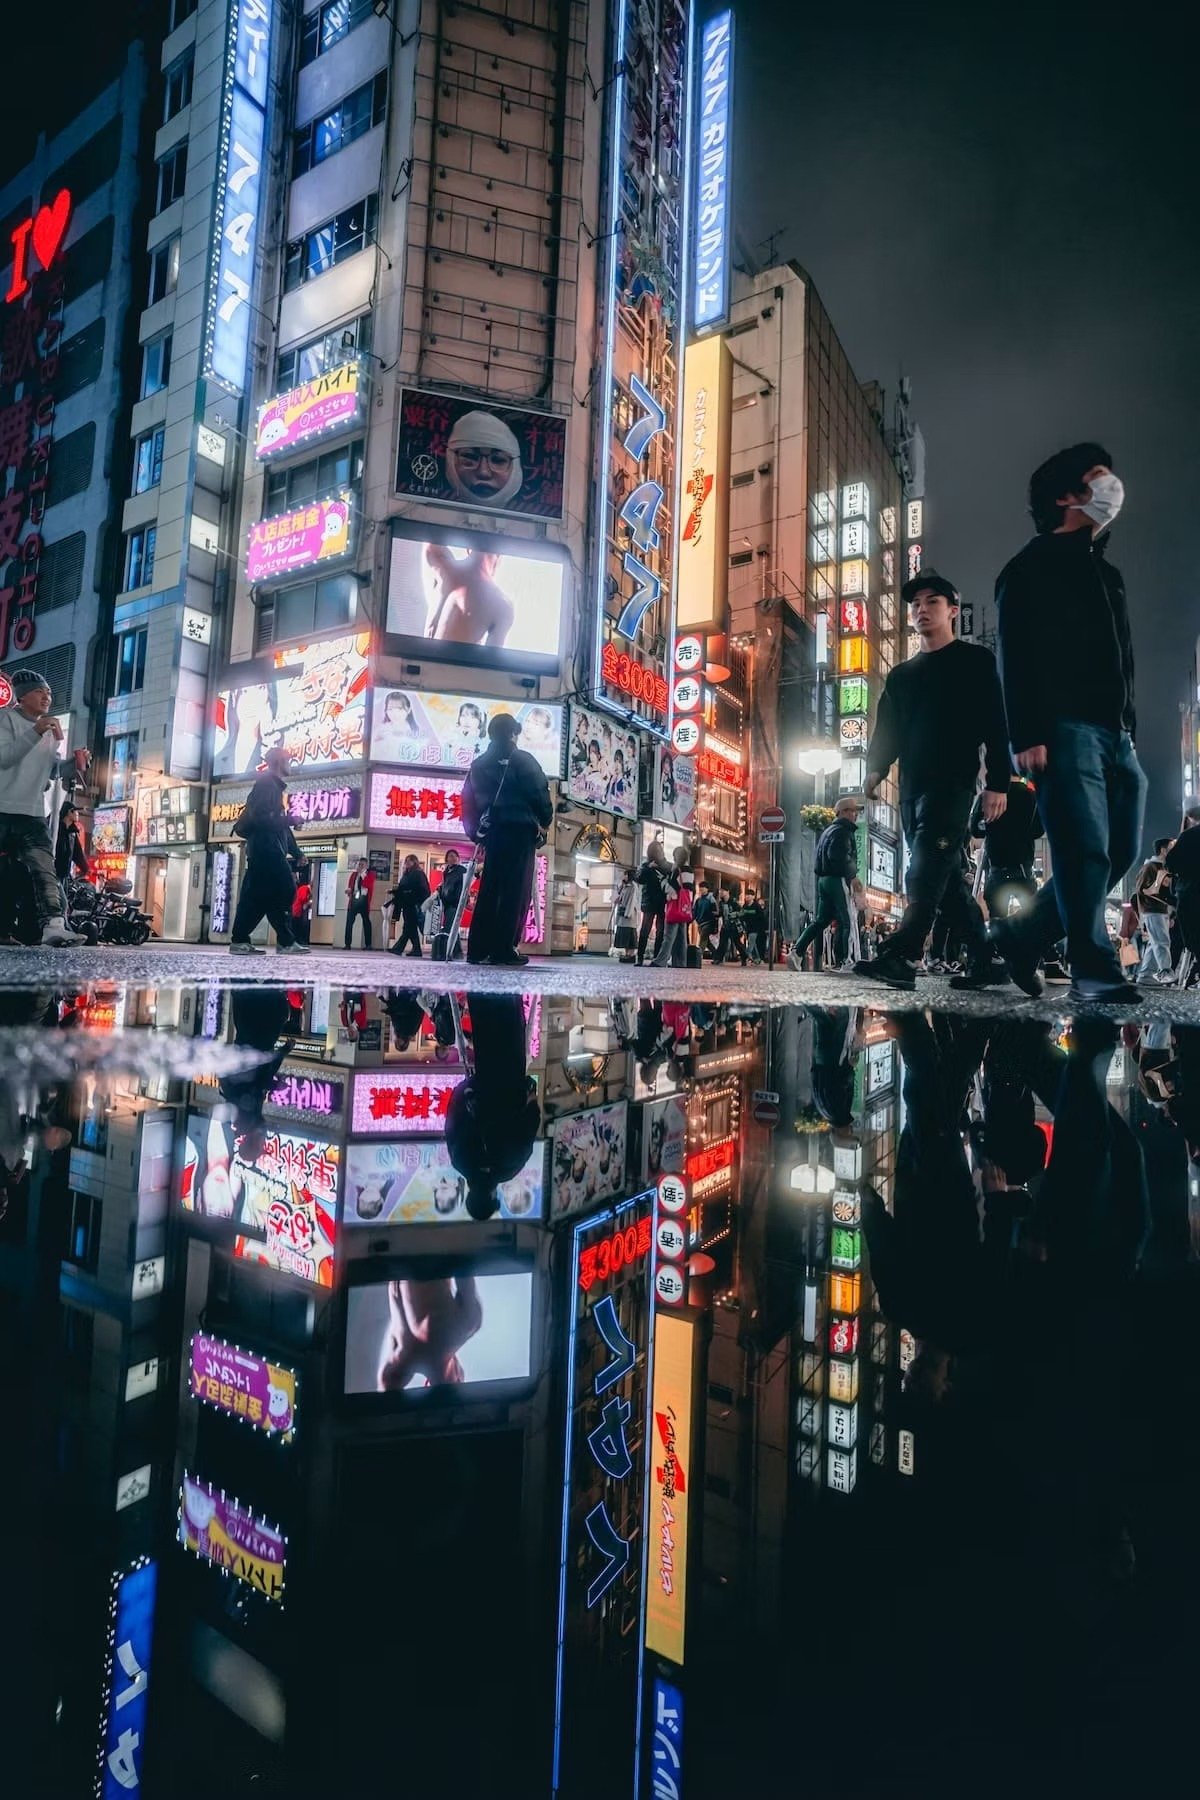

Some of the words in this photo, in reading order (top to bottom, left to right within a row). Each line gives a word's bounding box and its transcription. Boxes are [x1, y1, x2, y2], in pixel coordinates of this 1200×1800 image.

[217, 141, 259, 323] 747
[698, 25, 731, 314] 747カラオケランド
[250, 508, 320, 547] 入店応援金
[617, 374, 666, 641] 747
[290, 786, 351, 821] 案内所
